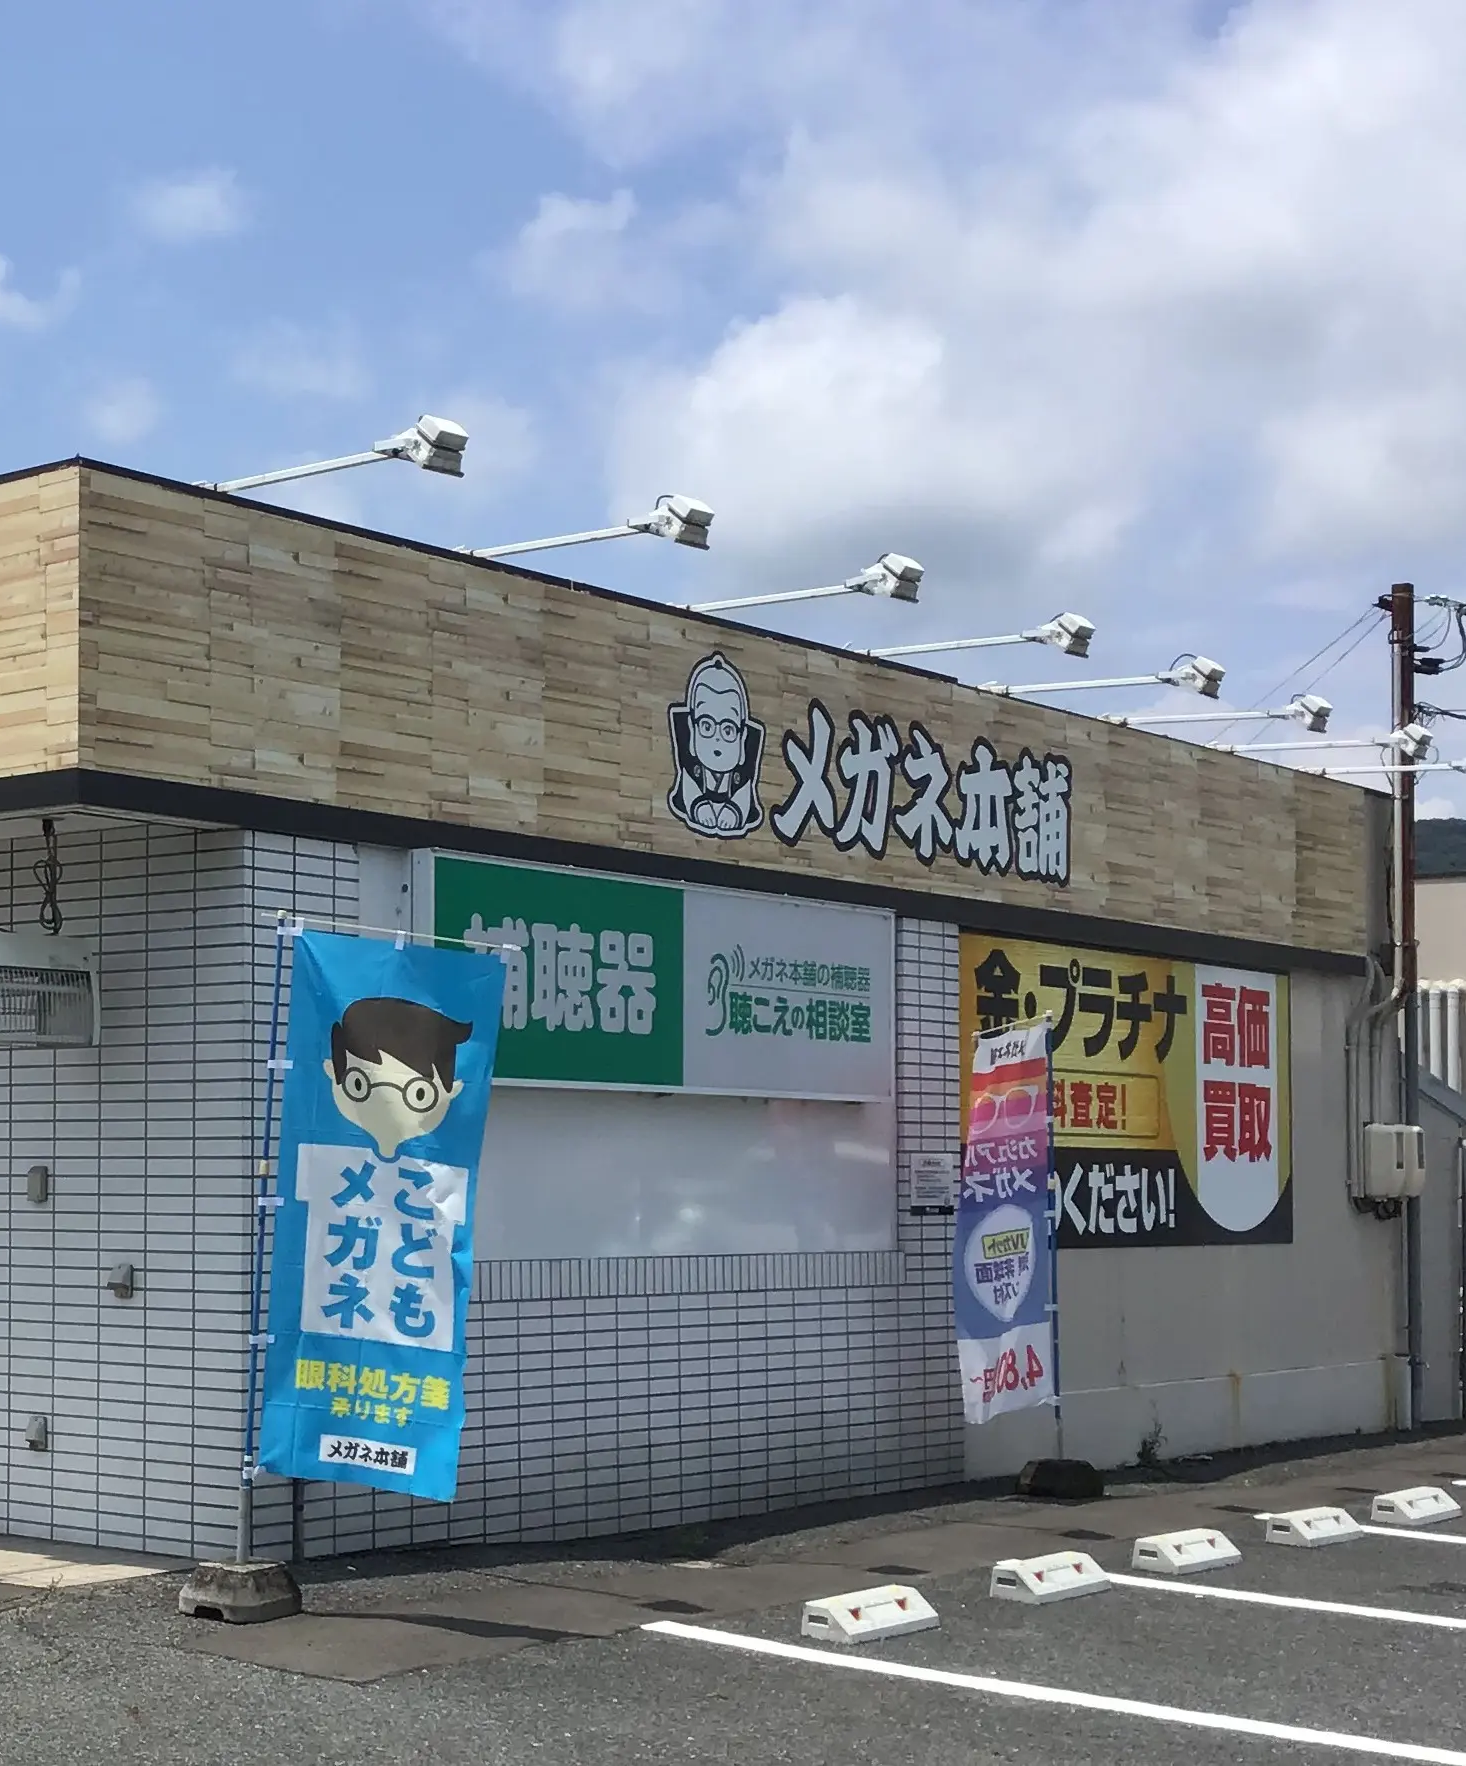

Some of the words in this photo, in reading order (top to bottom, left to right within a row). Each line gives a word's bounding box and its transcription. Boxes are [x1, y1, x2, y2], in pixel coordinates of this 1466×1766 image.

[774, 706, 1070, 881] メガネ本舗
[463, 912, 657, 1036] 補聴器
[748, 956, 871, 993] メガネ本舗の補聴器
[729, 991, 872, 1044] 聴こえの相談室
[1201, 982, 1271, 1069] 高価
[1202, 1079, 1273, 1164] 買取
[322, 1159, 382, 1332] メガネ
[390, 1167, 436, 1340] こども
[295, 1356, 451, 1411] 眼科処方箋
[329, 1398, 415, 1429] 承ります
[326, 1440, 408, 1471] メガネ本舗
